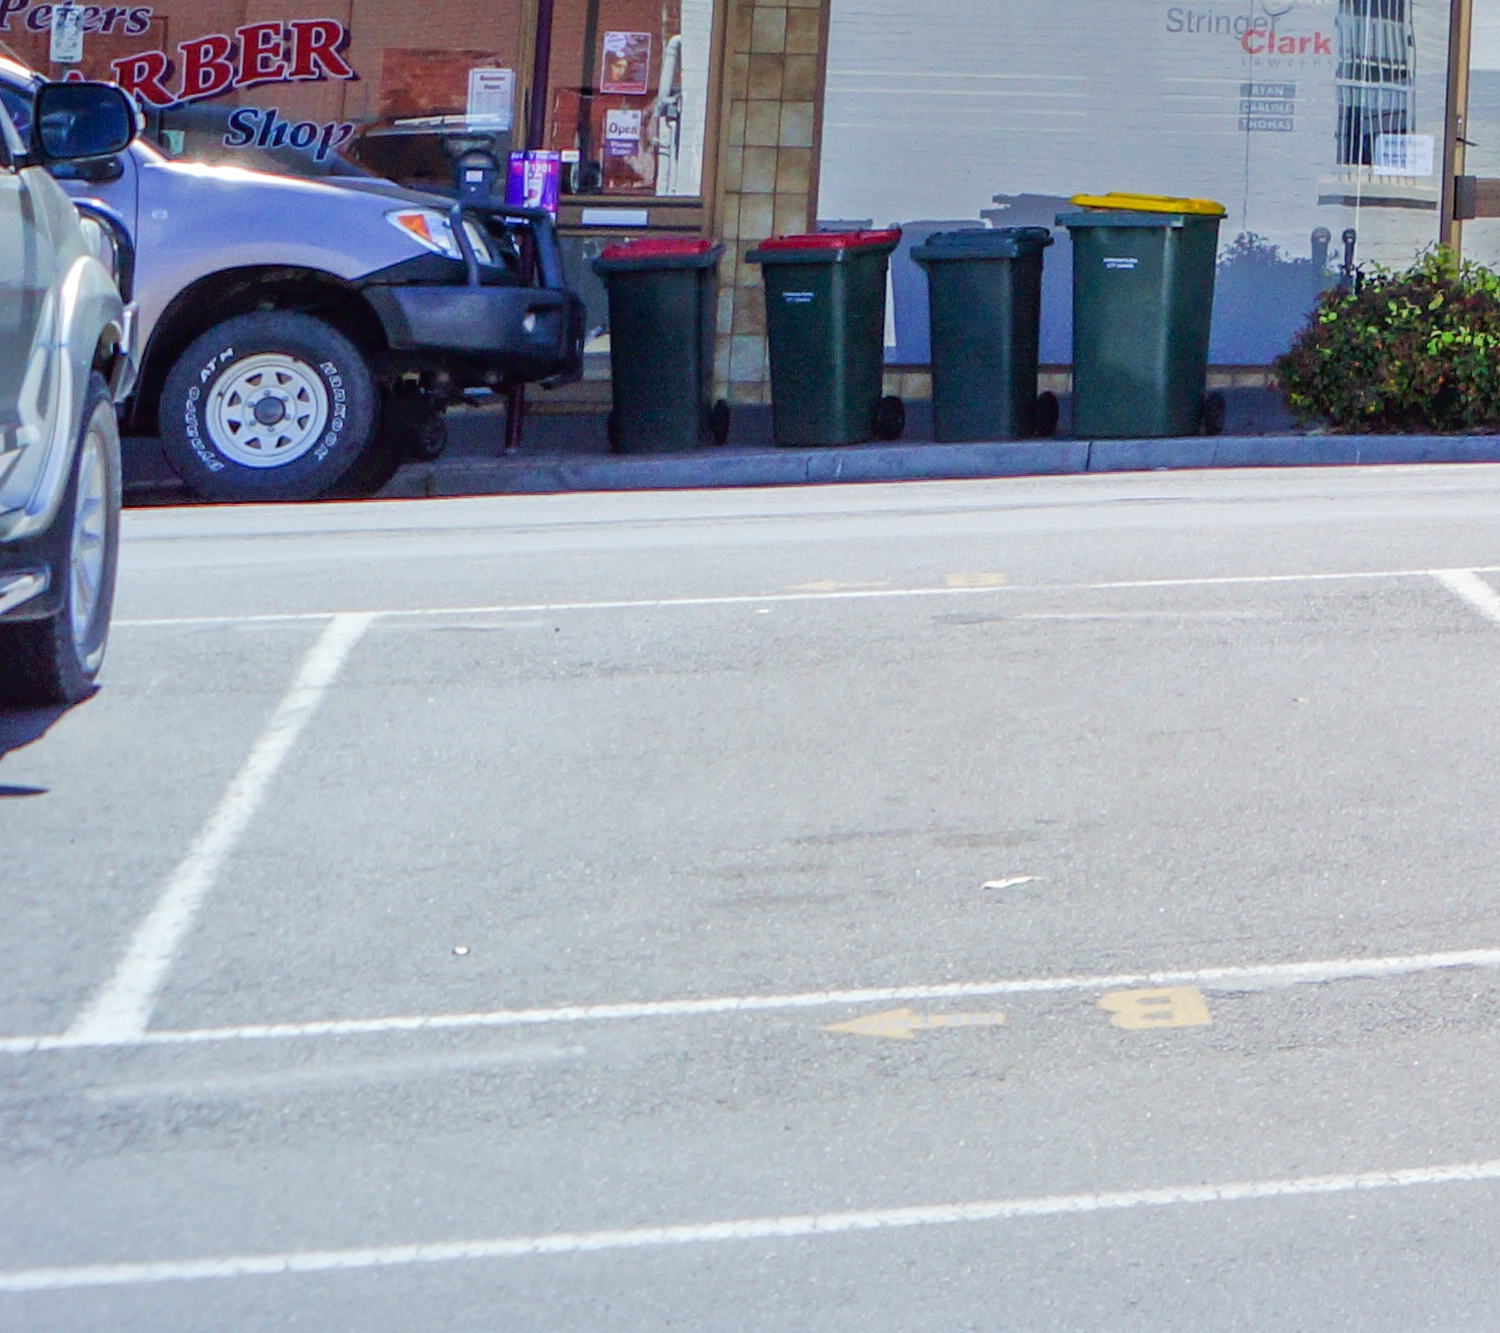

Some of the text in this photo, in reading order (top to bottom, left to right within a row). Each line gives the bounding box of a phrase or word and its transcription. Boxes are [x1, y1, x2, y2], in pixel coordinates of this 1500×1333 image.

[1165, 6, 1280, 40] Stringer
[1240, 28, 1334, 56] Clark
[223, 106, 355, 163] Shop
[608, 122, 638, 136] Open
